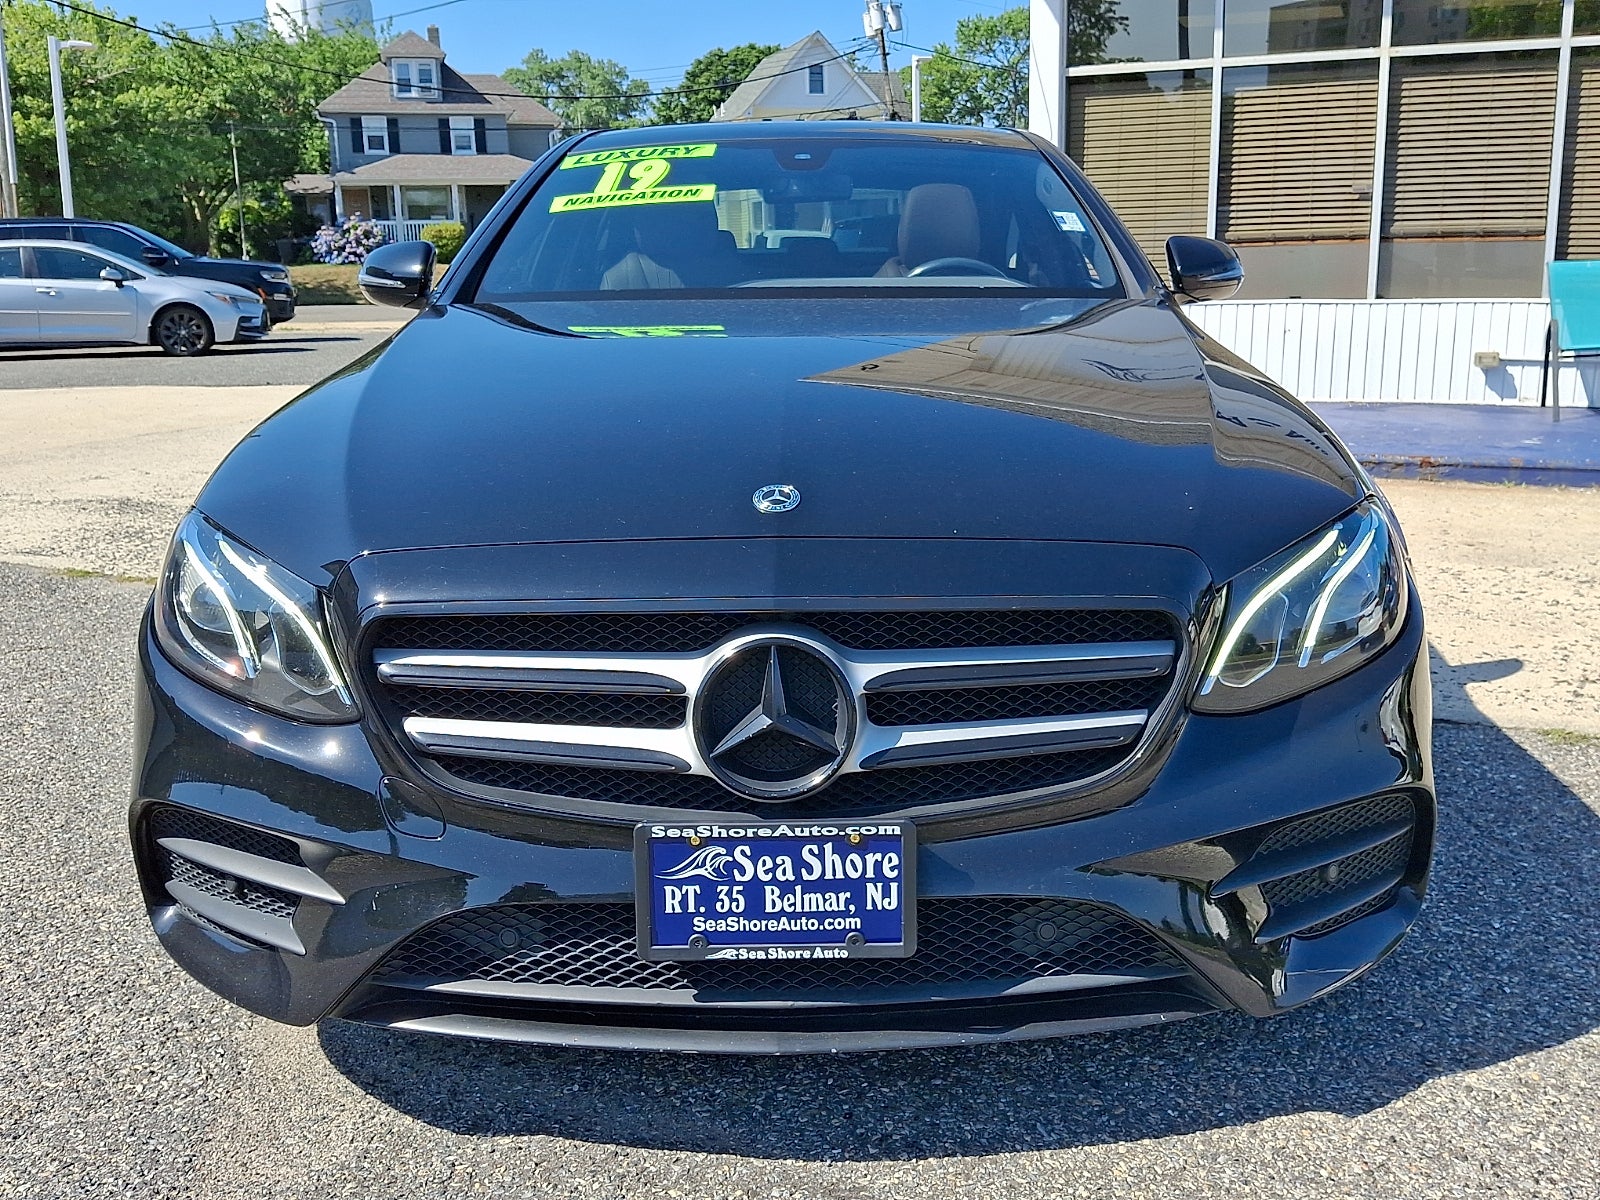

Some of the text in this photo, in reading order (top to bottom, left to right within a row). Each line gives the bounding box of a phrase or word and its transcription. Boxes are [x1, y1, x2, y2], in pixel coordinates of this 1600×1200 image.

[573, 146, 703, 165] LUXURY
[594, 158, 671, 193] 19
[563, 188, 701, 207] NAVIGATION
[651, 824, 901, 838] SeaShoreAuto.com
[733, 842, 899, 882] Sea Shore
[664, 882, 899, 915] RT. 35 Belmar, NJ
[692, 916, 861, 932] SeaShoreAuto.com
[738, 947, 849, 960] Sea Shore Auto
